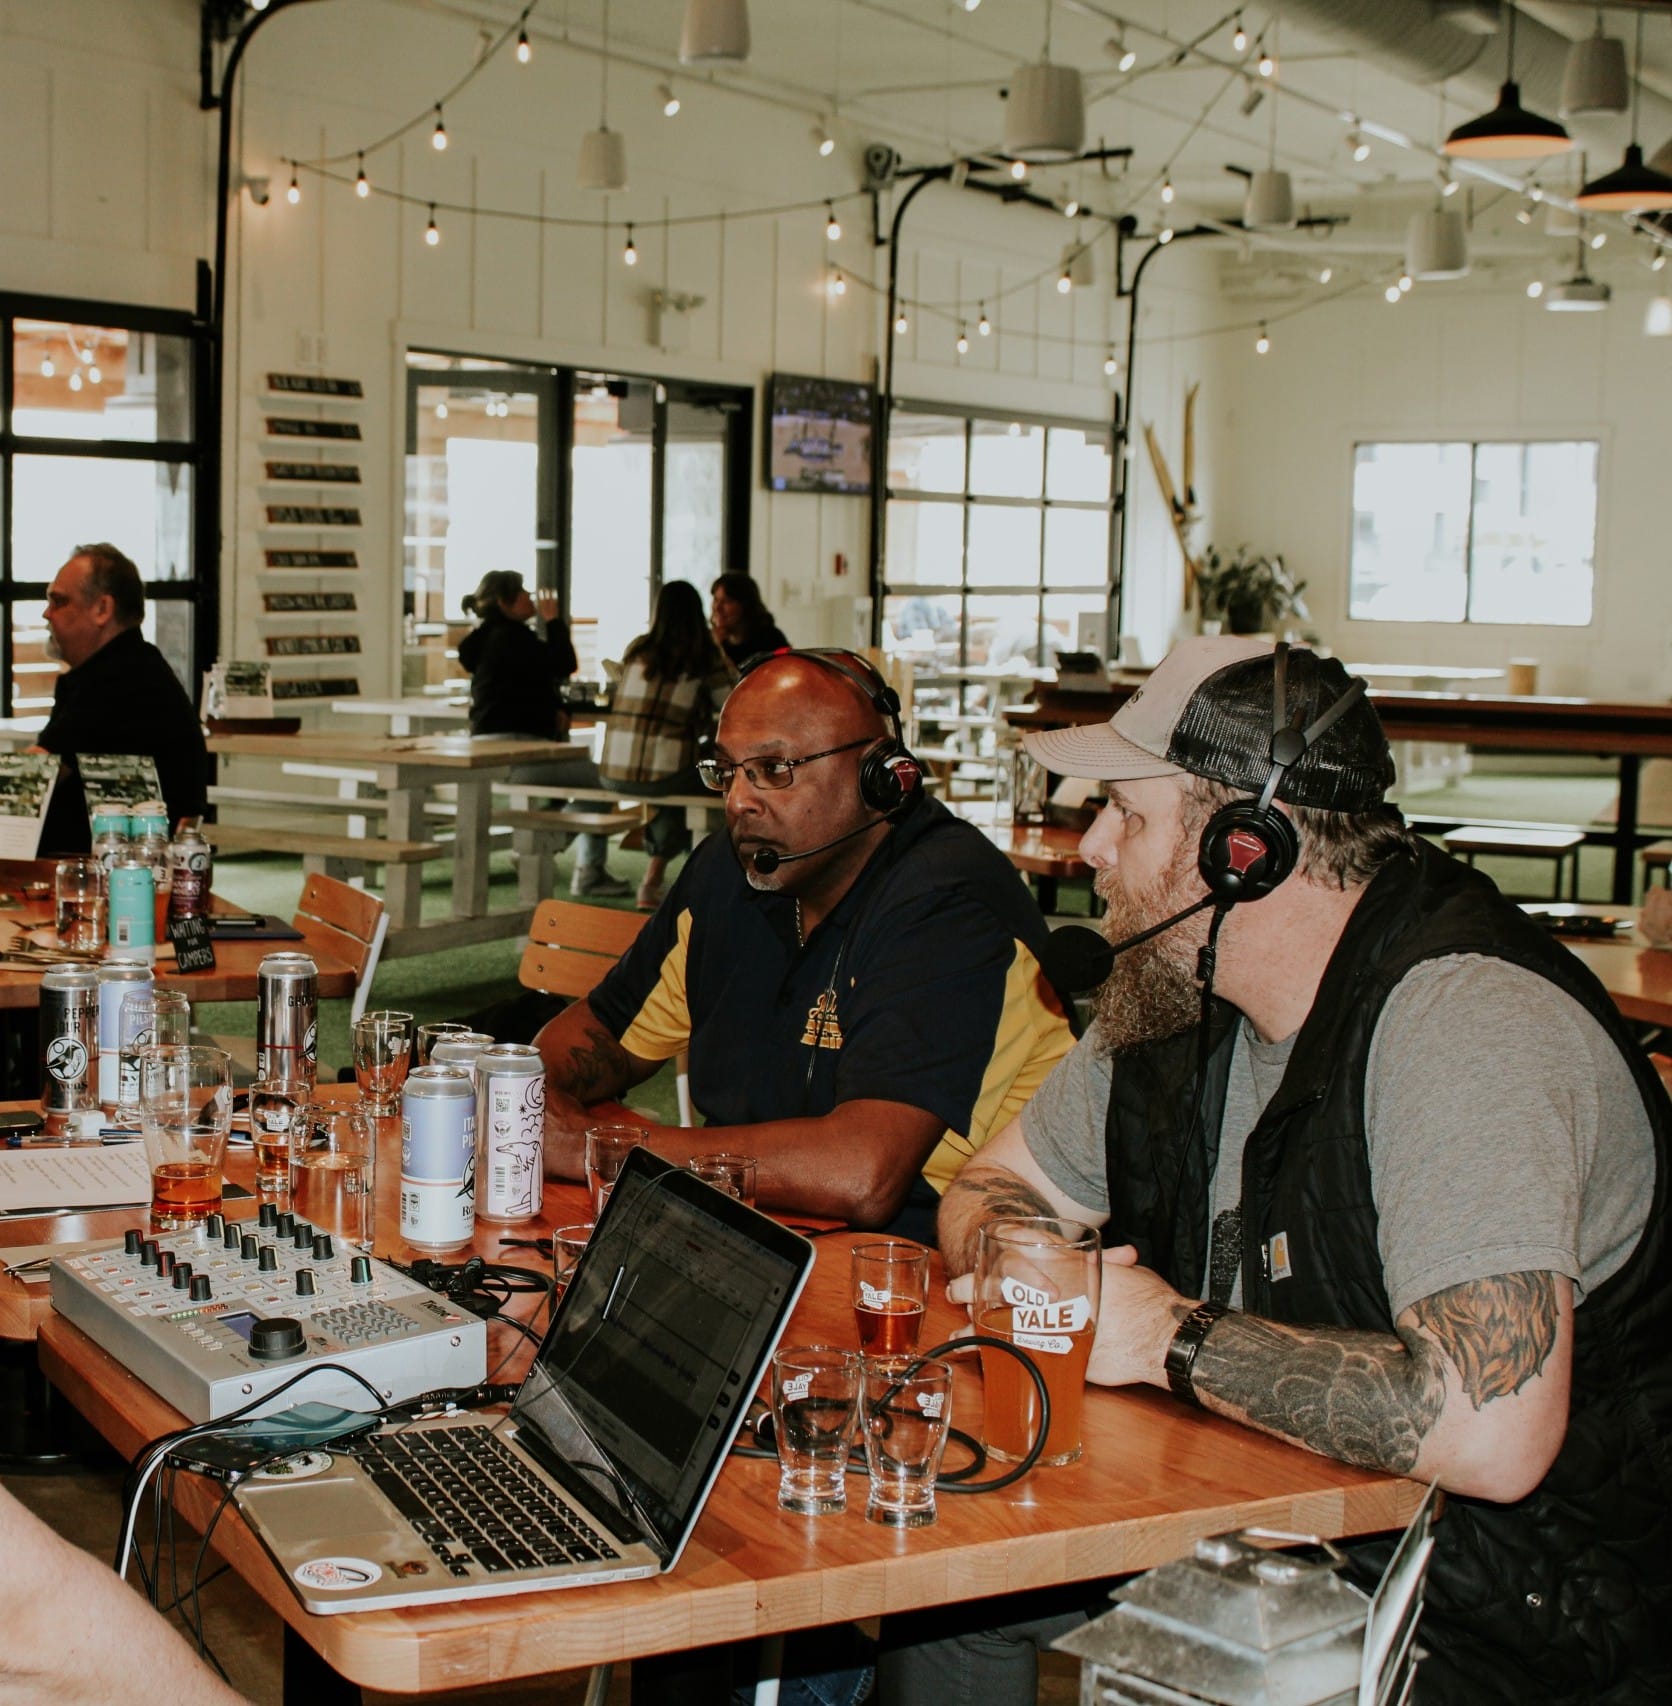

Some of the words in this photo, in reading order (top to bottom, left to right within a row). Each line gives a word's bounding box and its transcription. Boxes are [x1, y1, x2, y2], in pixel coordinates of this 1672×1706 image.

[178, 947, 213, 968] CAMPERS
[1012, 1285, 1045, 1306] OLD
[1017, 1303, 1074, 1329] YALE
